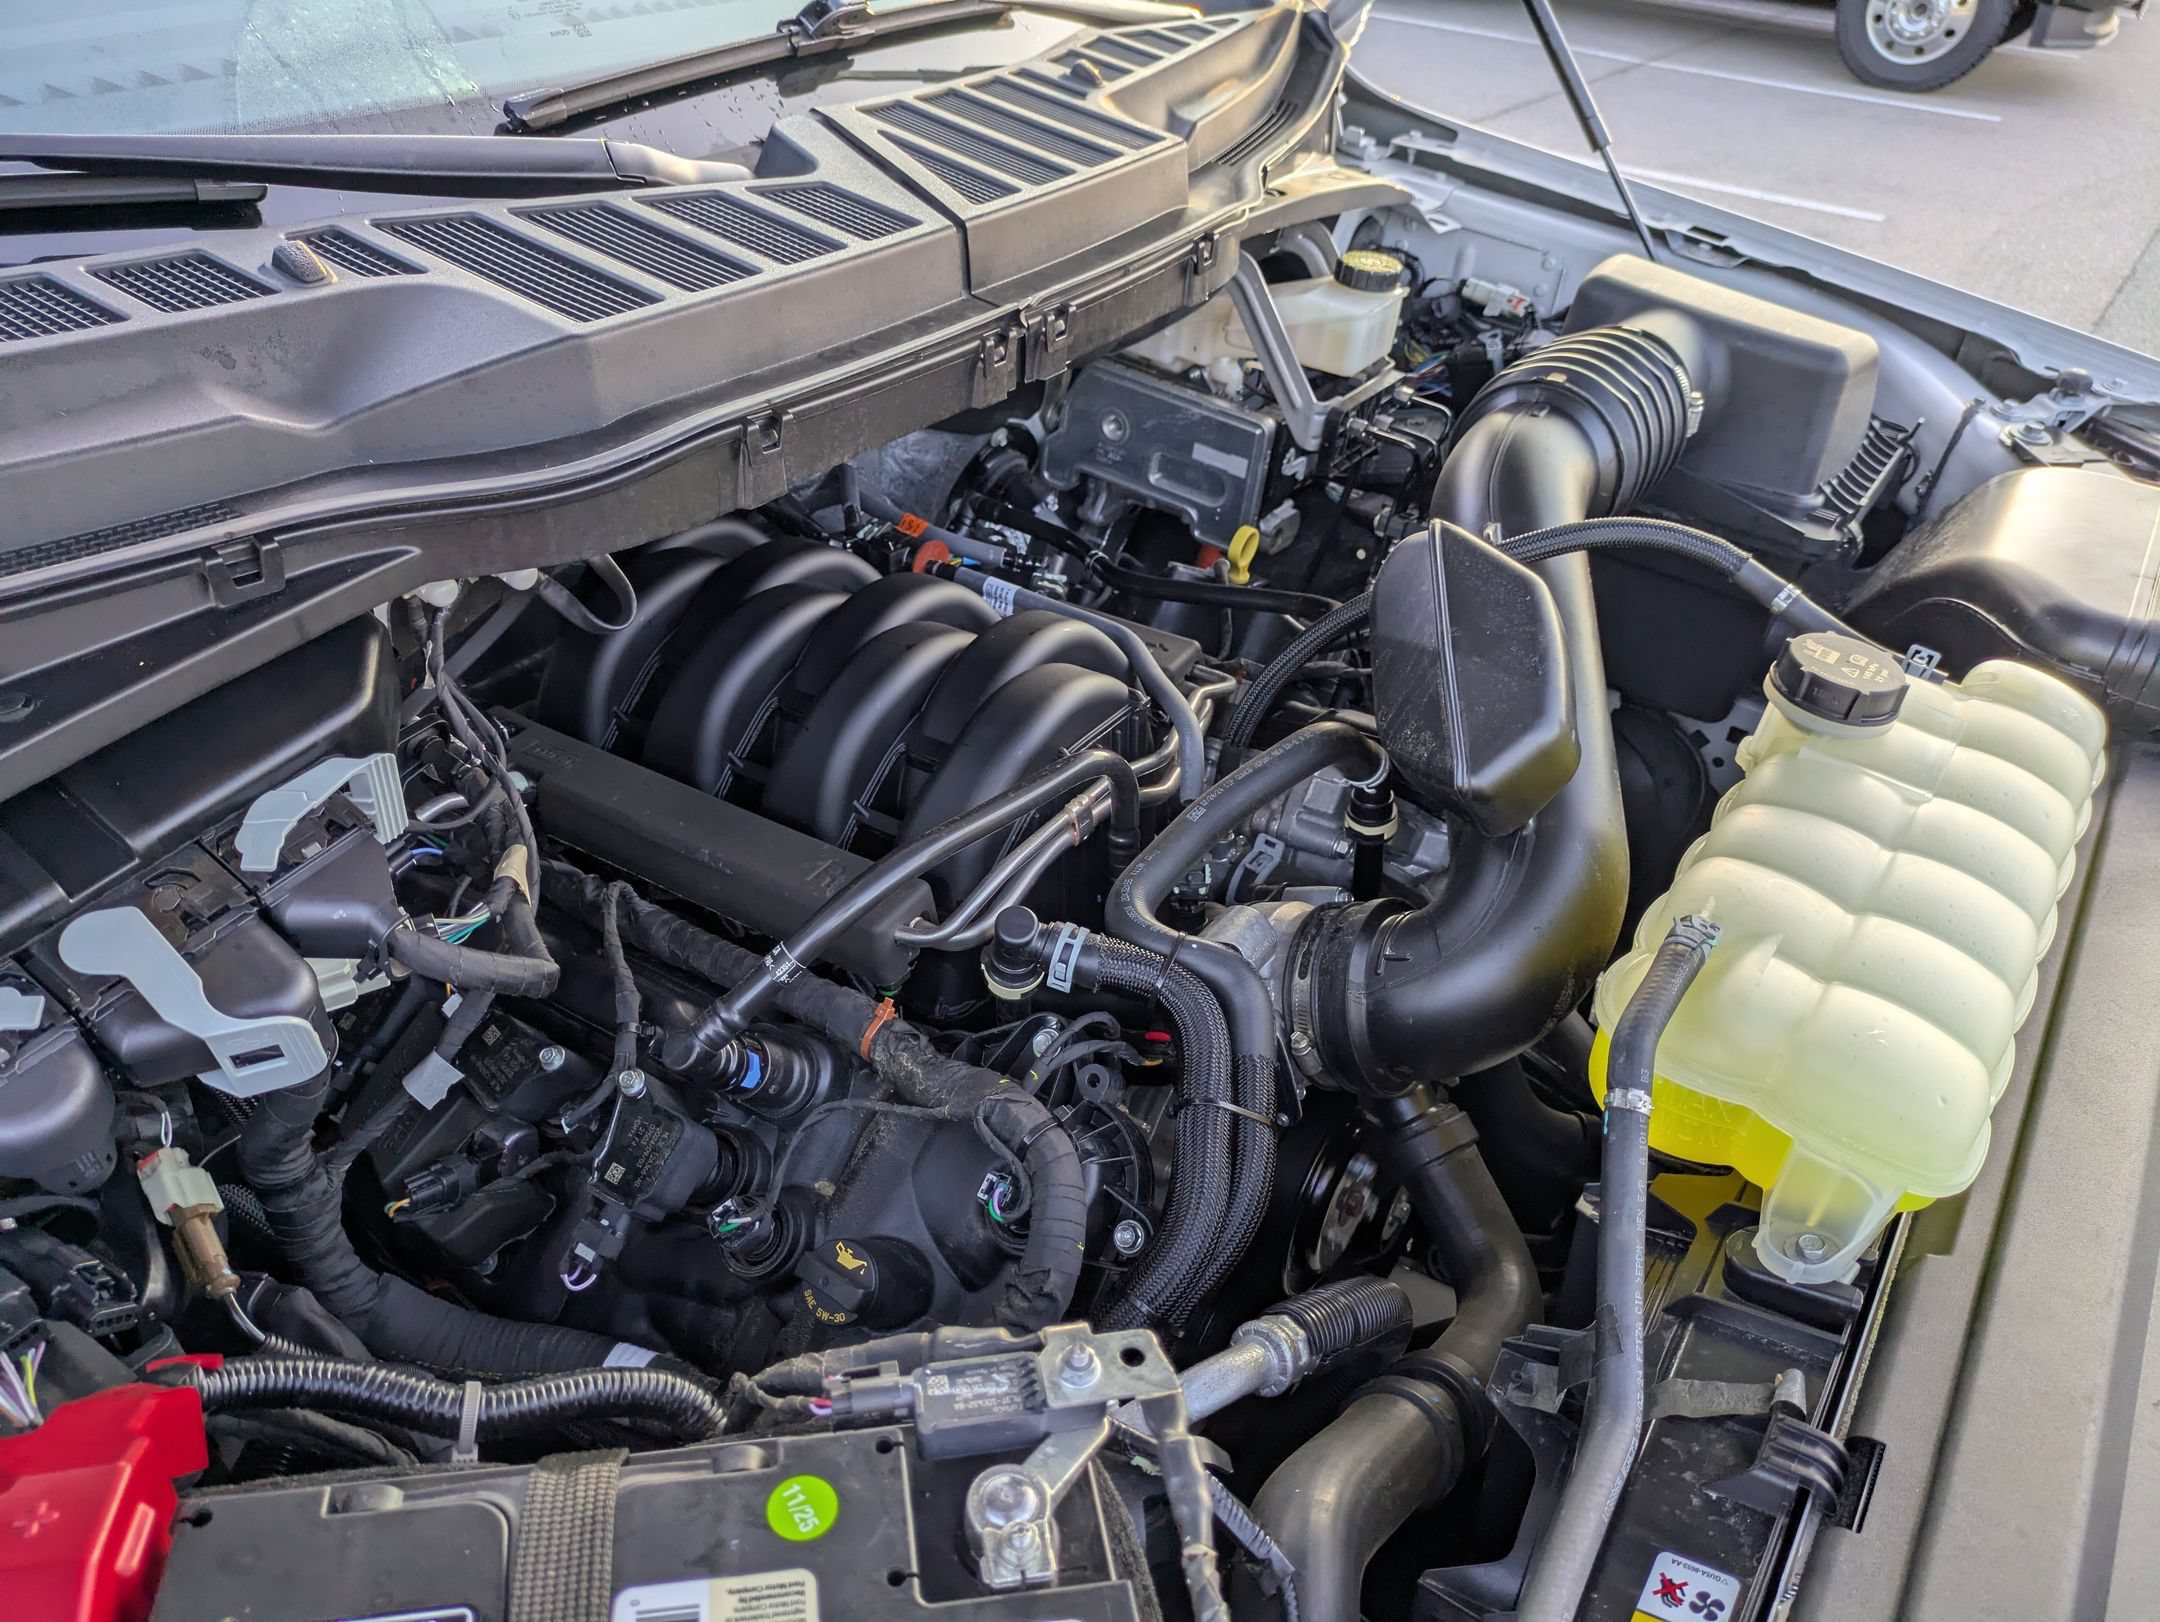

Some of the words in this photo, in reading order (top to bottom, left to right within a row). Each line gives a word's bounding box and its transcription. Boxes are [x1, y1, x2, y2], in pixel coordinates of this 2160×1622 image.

[1641, 1068, 1650, 1084] B3
[804, 1289, 817, 1309] SAE
[816, 1307, 846, 1322] 5W-30
[782, 1483, 821, 1532] 11/25
[726, 1584, 763, 1595] Company.
[765, 1582, 785, 1592] Motor
[786, 1580, 806, 1589] Ford
[737, 1596, 750, 1604] by
[751, 1590, 806, 1602] Recommended
[767, 1601, 787, 1610] Motor
[787, 1599, 806, 1607] Ford
